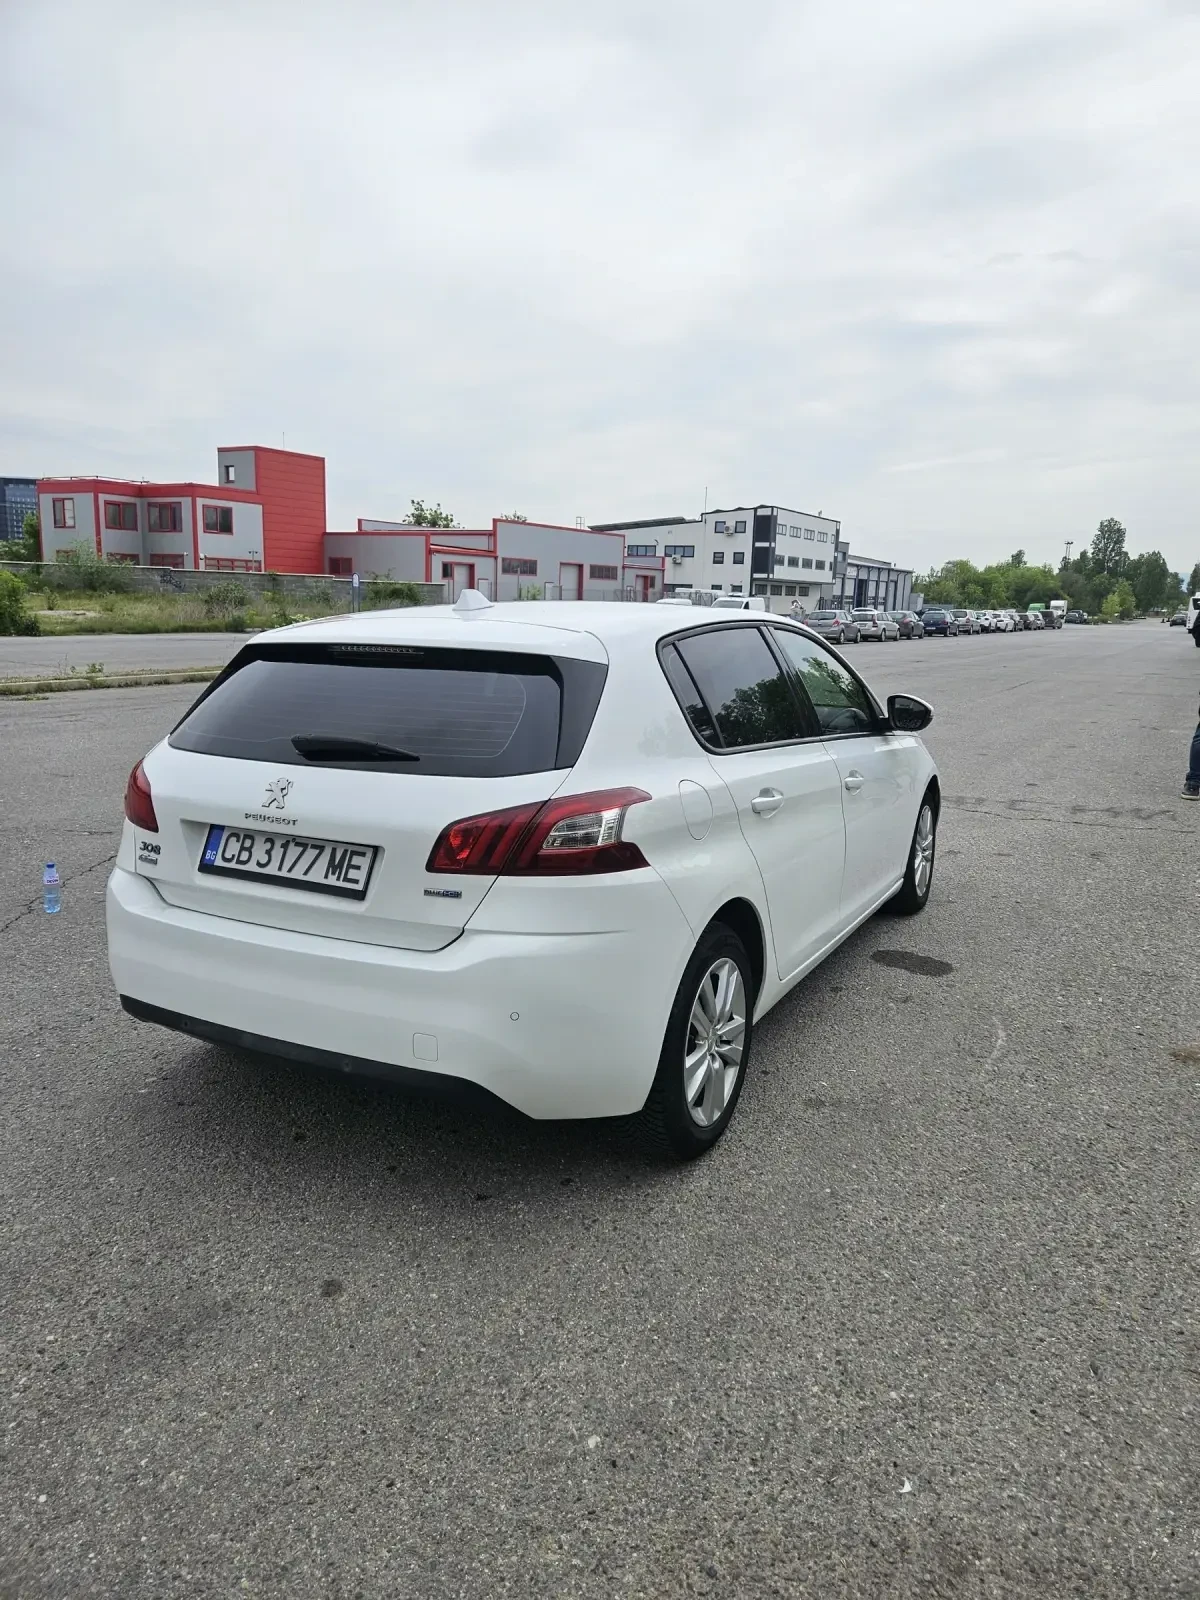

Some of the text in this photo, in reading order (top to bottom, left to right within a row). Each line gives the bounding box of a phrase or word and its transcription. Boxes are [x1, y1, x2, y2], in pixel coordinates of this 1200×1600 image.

[245, 813, 298, 826] PEUGEOT
[140, 841, 161, 855] 308
[205, 850, 217, 860] BG
[221, 832, 367, 884] CB 3177 ME
